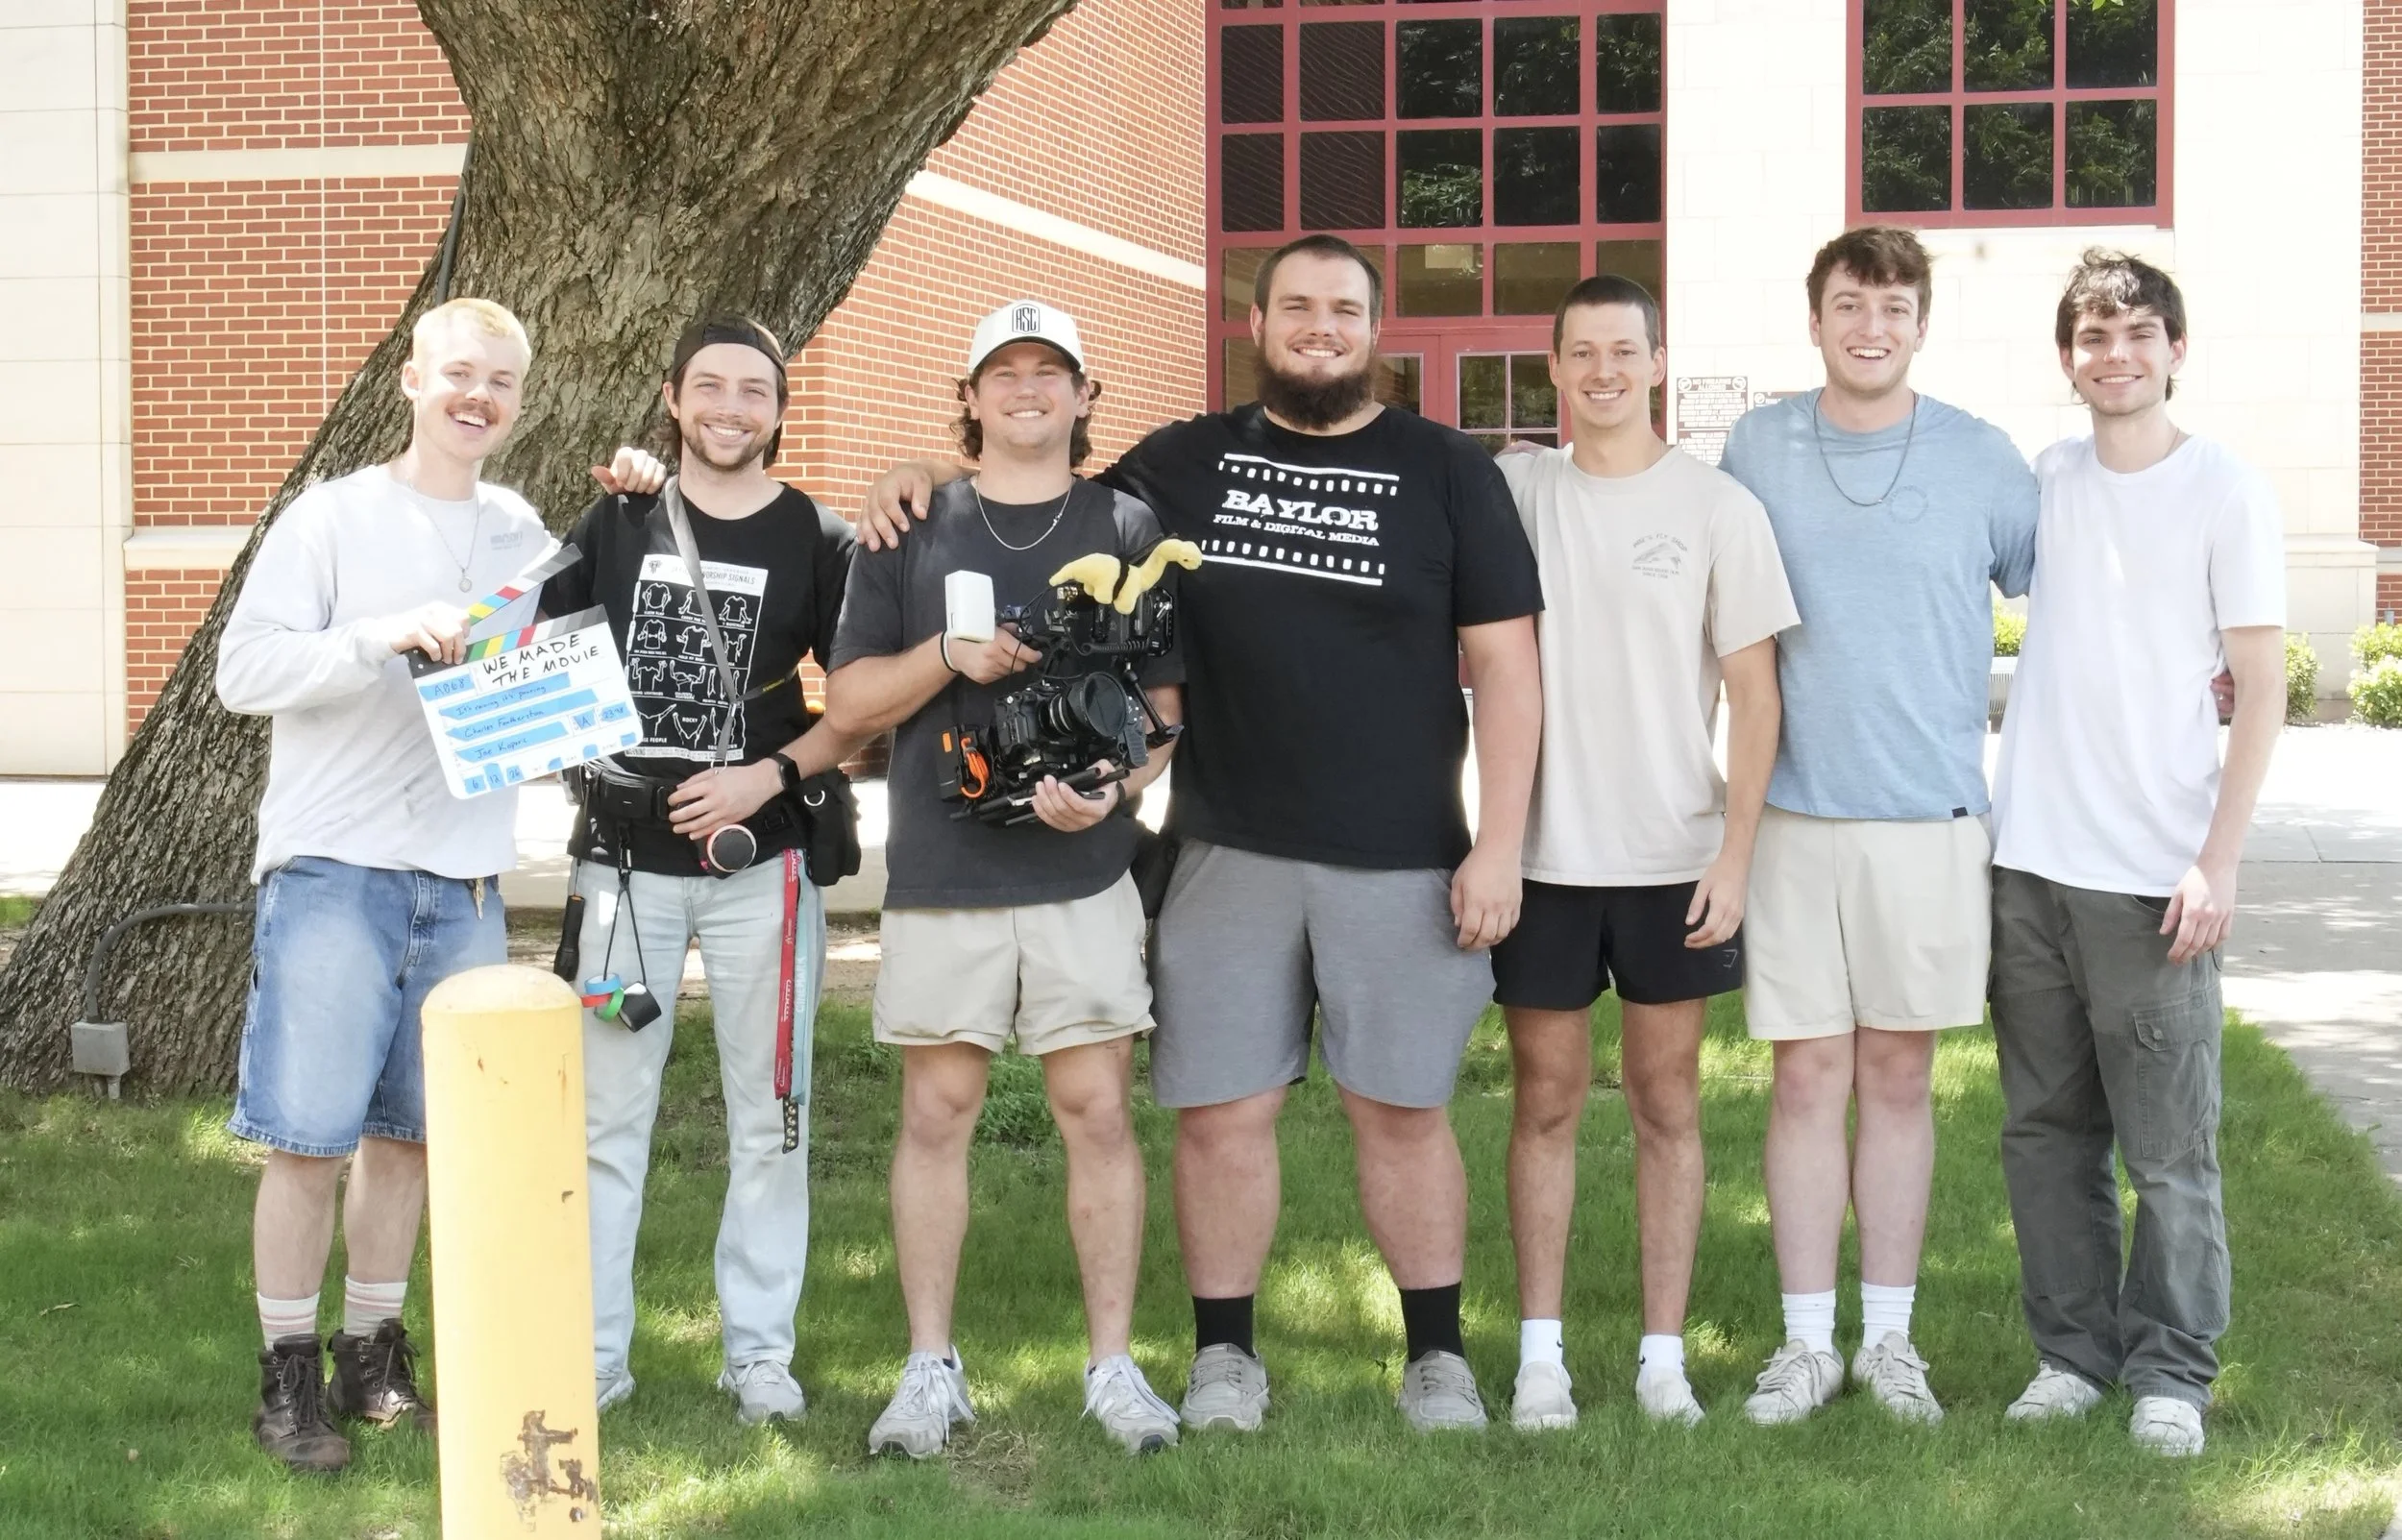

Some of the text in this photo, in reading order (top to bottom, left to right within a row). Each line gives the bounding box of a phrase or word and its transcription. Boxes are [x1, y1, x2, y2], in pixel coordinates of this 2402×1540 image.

[1222, 490, 1378, 531] BAYLOR
[1213, 514, 1380, 546] FILM & DIGITAL MEDIA
[728, 573, 756, 584] SIGNALS
[483, 634, 580, 674] WE MADE
[492, 646, 600, 686] THE MOVIE
[475, 747, 493, 759] Joe
